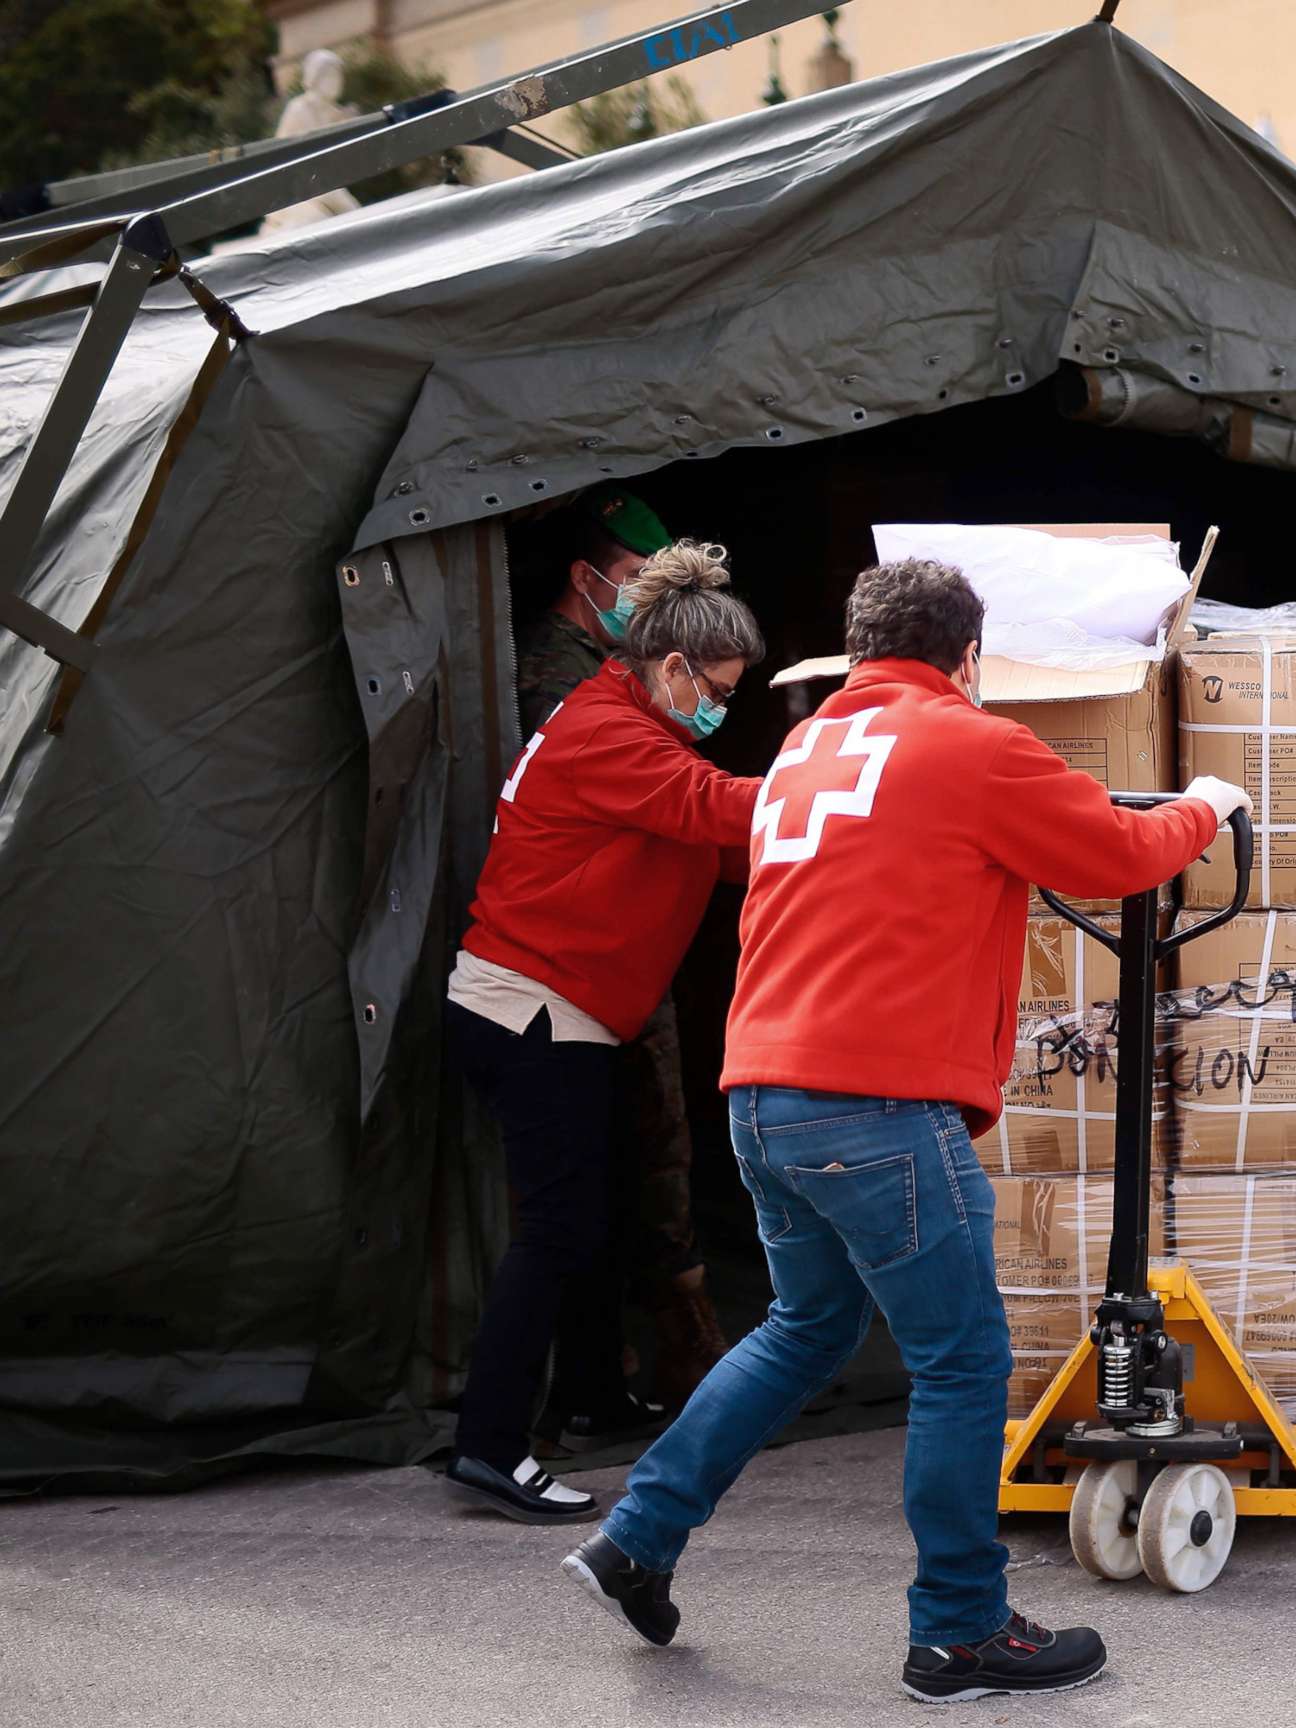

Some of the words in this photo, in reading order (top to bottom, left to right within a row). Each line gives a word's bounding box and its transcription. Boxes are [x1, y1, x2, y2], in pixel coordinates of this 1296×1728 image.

[1228, 682, 1262, 690] WESSCO
[1028, 1000, 1070, 1012] AIRLINES
[1011, 1086, 1020, 1096] IN
[1024, 1085, 1053, 1096] CHINA
[1026, 1258, 1067, 1269] AIRLINES
